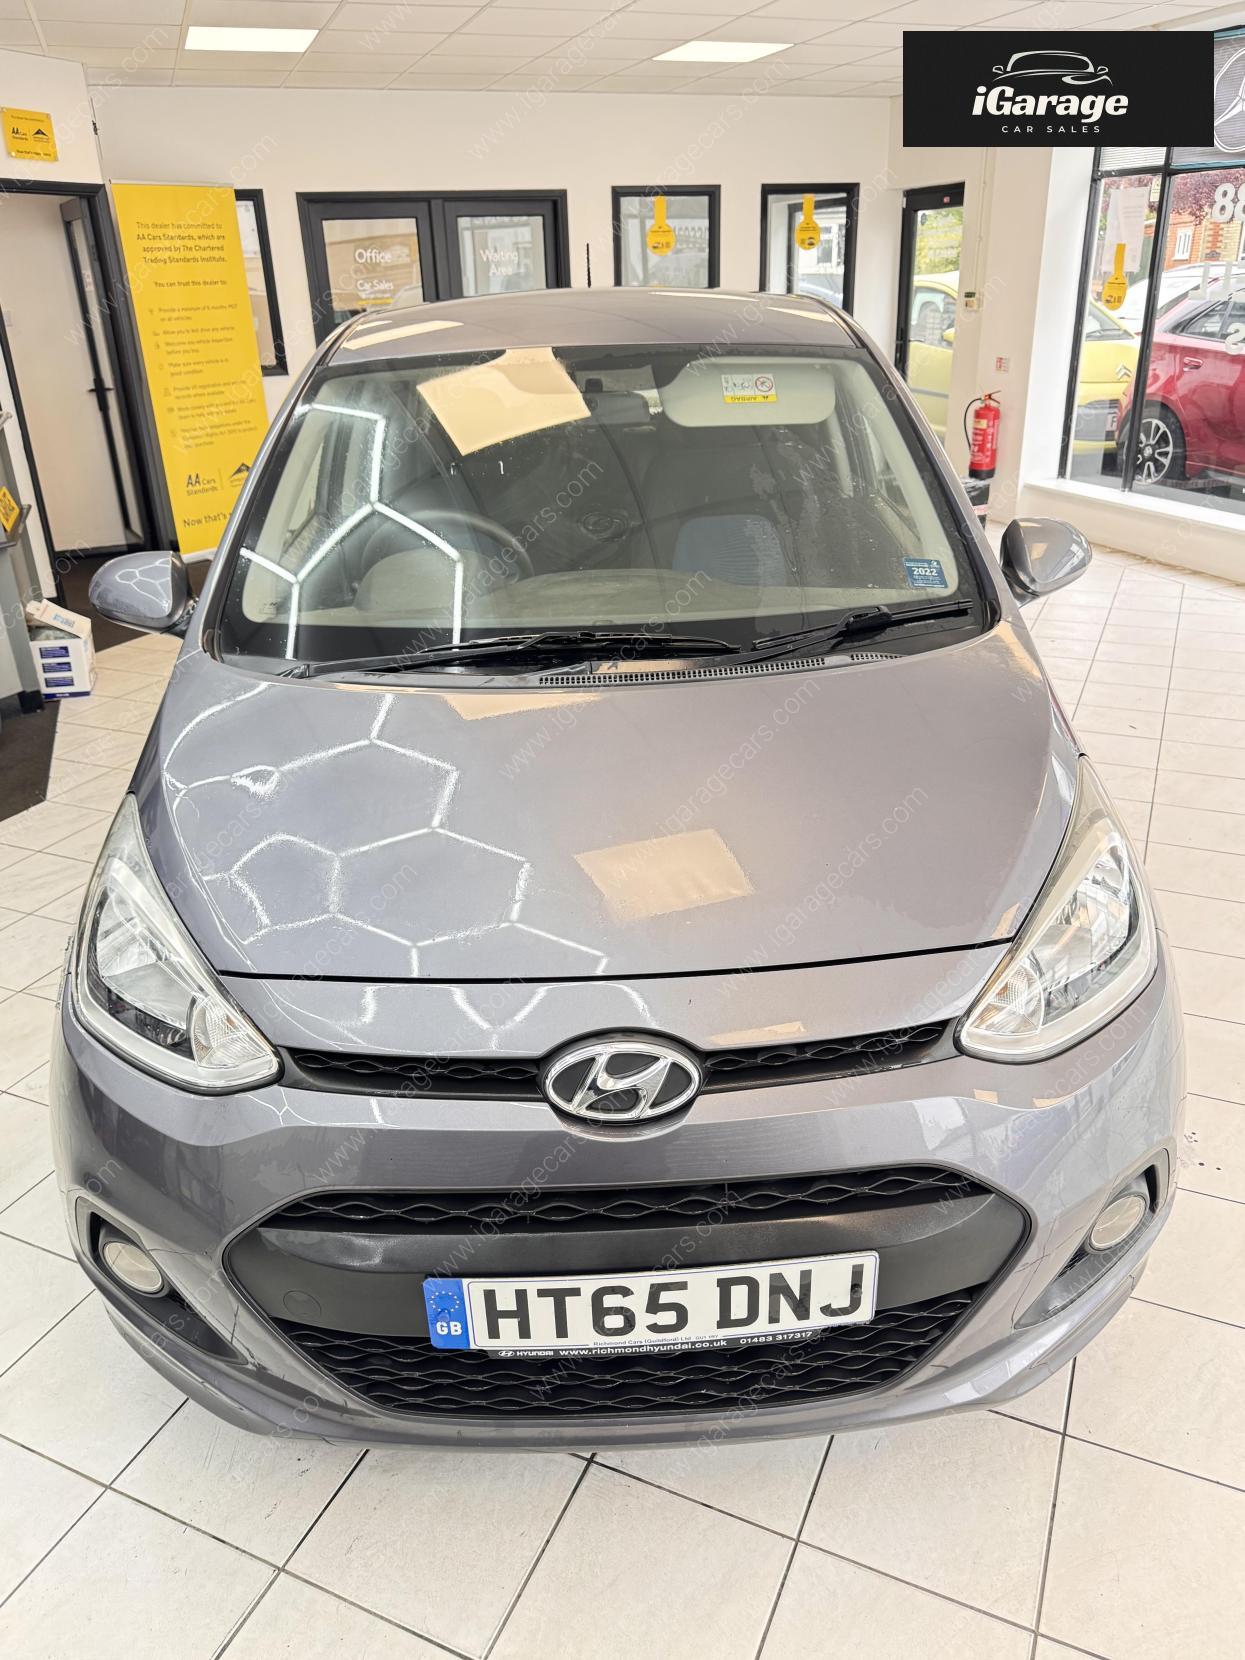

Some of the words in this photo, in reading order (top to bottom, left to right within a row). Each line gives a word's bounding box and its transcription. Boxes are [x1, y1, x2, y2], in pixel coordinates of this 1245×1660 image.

[355, 248, 392, 263] Office
[480, 249, 519, 263] Waiting
[489, 264, 512, 276] Area
[357, 280, 372, 290] Car
[373, 280, 394, 290] Sales
[186, 473, 201, 488] AA
[187, 486, 218, 496] Standards
[183, 518, 202, 528] Now
[204, 512, 227, 523] that's
[912, 568, 938, 576] 2022
[483, 1280, 688, 1340] HT65
[716, 1264, 864, 1330] DNJ
[436, 1320, 462, 1336] GB
[560, 1340, 727, 1355] www.richmondhyundai.co.uk
[740, 1336, 772, 1344] 01483
[776, 1332, 812, 1341] 317317
